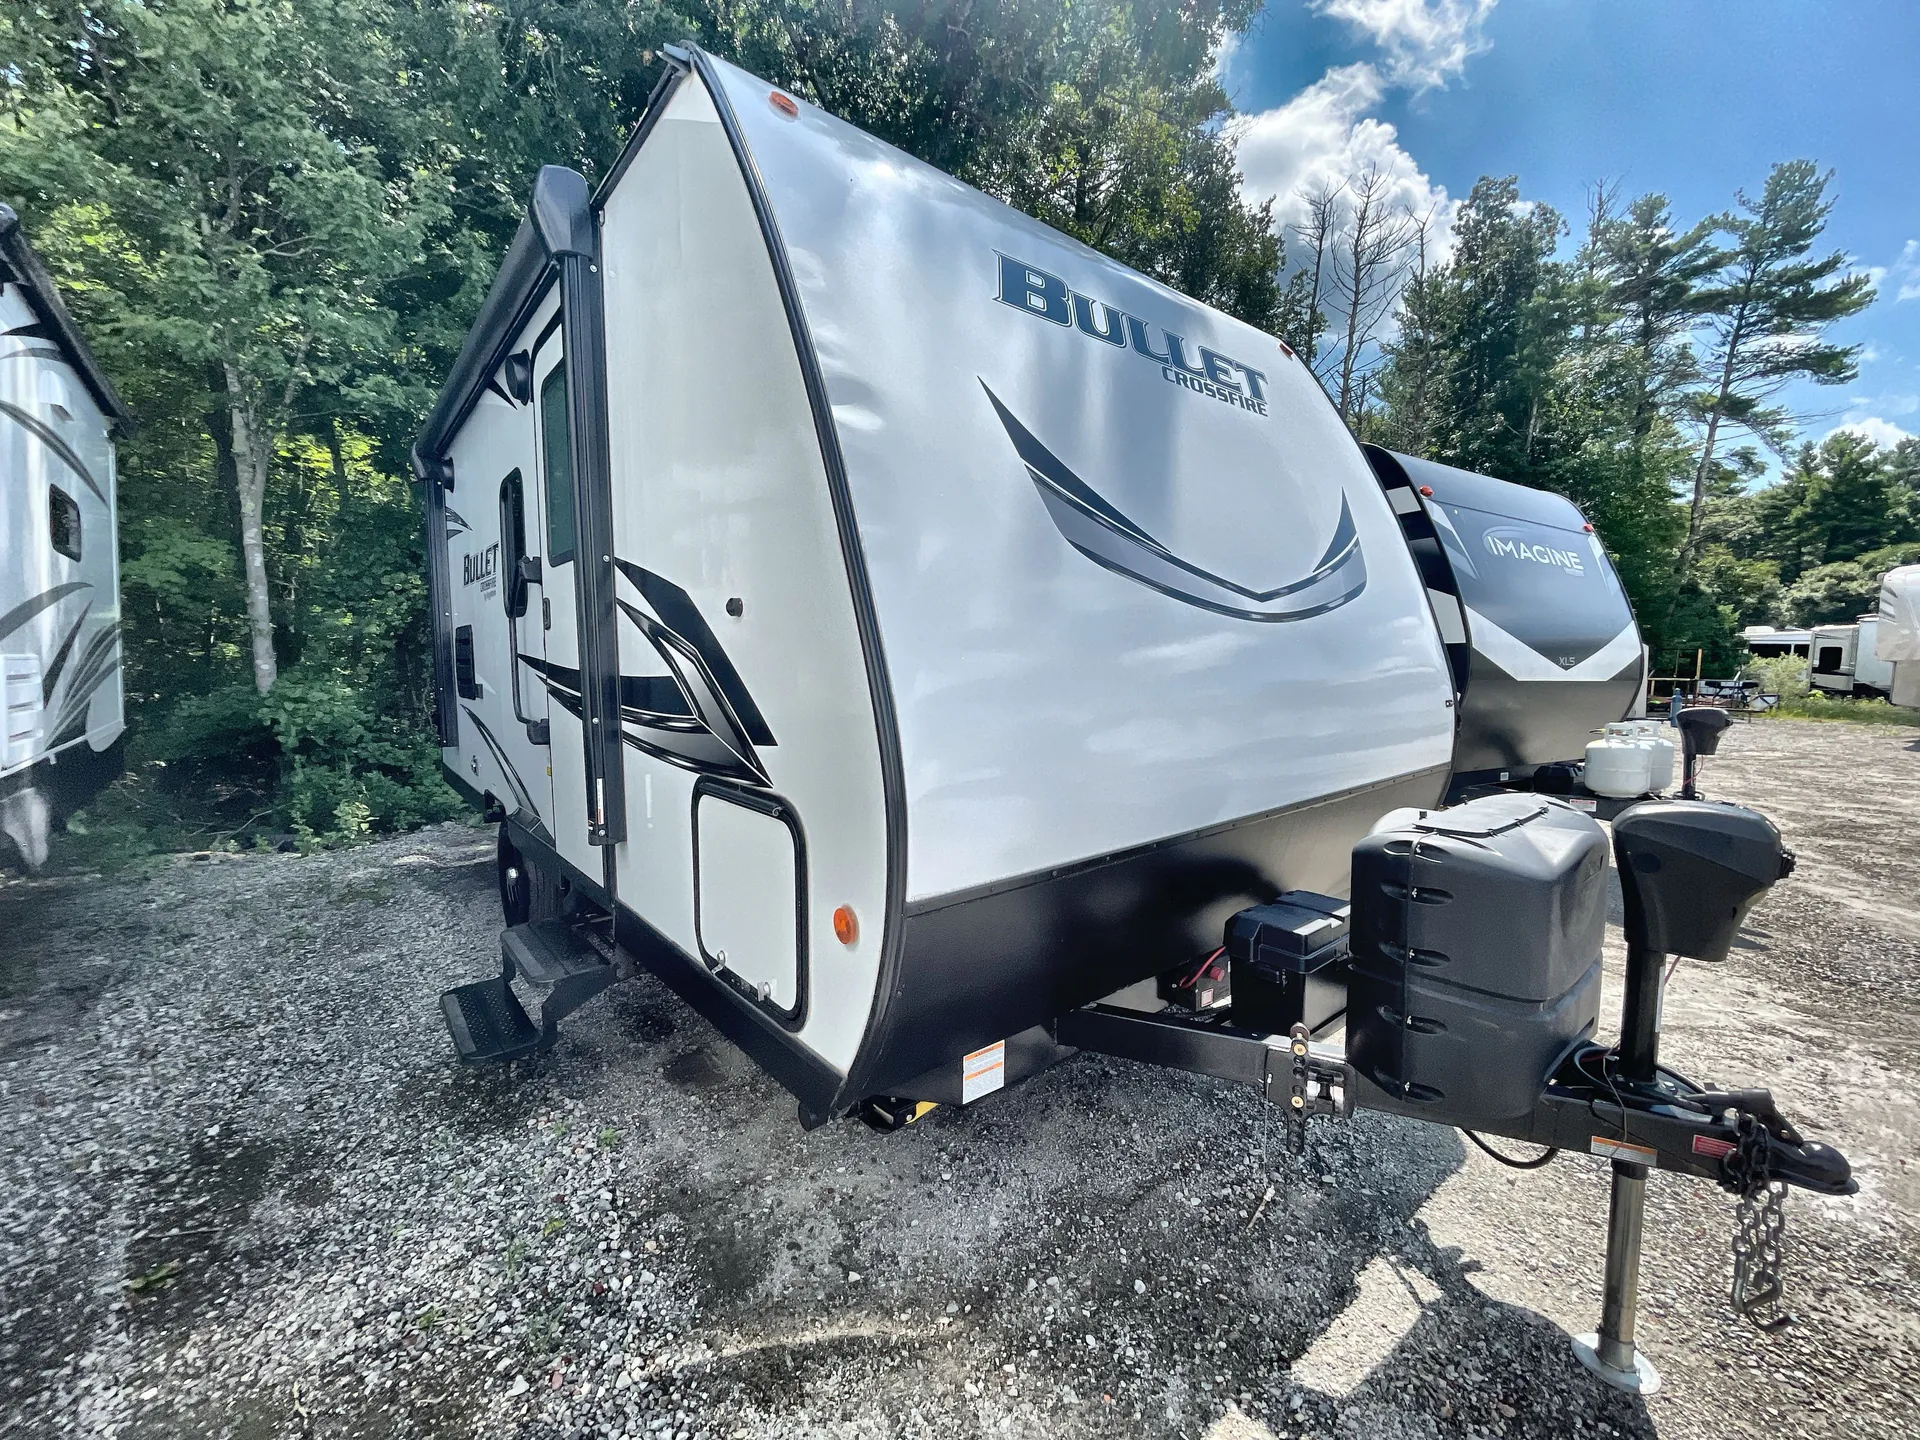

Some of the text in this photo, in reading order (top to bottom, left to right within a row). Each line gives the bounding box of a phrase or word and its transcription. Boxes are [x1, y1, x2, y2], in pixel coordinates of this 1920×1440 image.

[991, 248, 1269, 404] BULLET
[1161, 365, 1269, 418] CROSSFIRE
[463, 540, 499, 588] BULLET
[1487, 535, 1584, 570] IMAGINE
